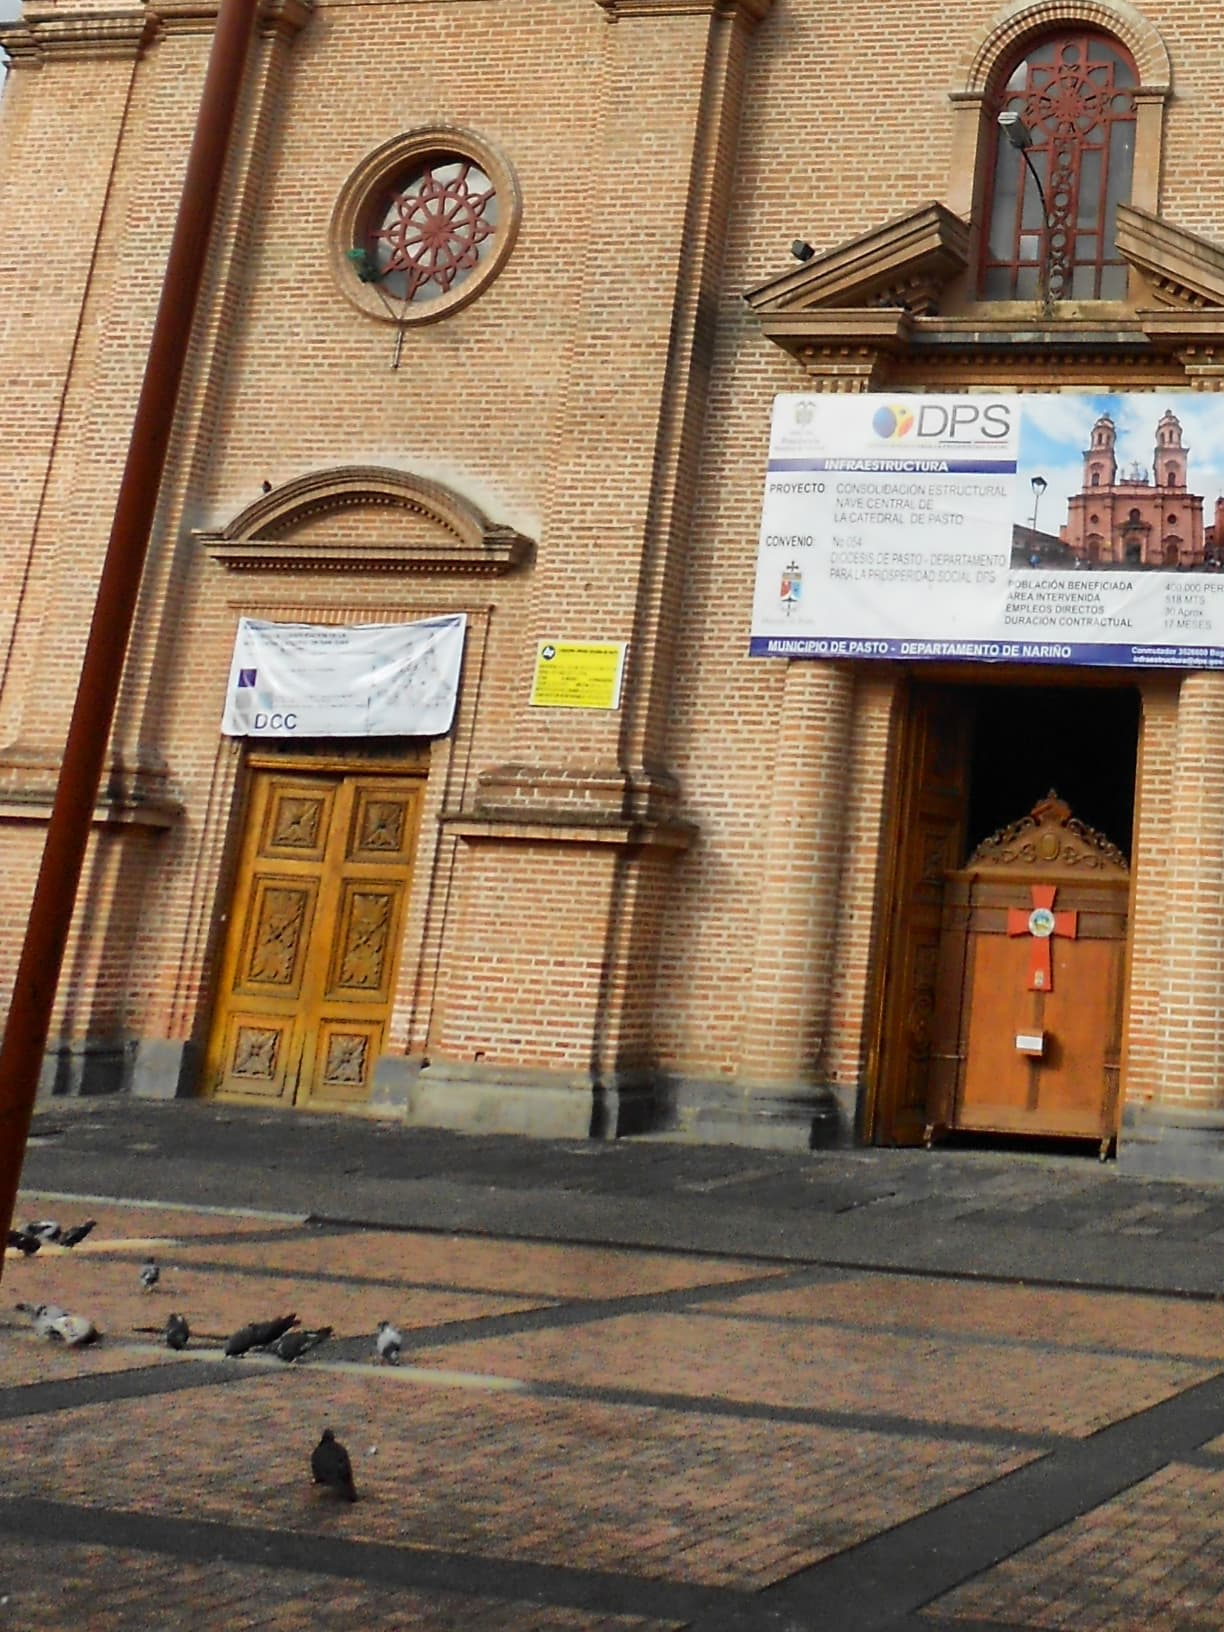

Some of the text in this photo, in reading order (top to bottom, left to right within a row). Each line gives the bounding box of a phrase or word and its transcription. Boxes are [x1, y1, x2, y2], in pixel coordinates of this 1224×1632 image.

[917, 403, 1011, 438] DPS
[824, 459, 949, 472] INFRAESTRUCTURA
[769, 482, 826, 494] PROYECTO
[928, 484, 1007, 497] ESTRUCTURAL
[836, 497, 934, 510] NAVE CENTRAL DE
[834, 512, 965, 525] LA CATEDRAL DE PASTO
[876, 552, 889, 565] DE
[892, 552, 921, 566] PASTO
[930, 553, 1006, 567] DEPARTAMENTO
[830, 567, 853, 580] PARA
[855, 568, 865, 580] LA
[869, 568, 935, 582] PROSPERIDAD
[938, 569, 971, 583] SOCIAL
[1008, 579, 1065, 590] POBLACIÓN
[1068, 580, 1133, 591] BENEFICIADA
[1036, 592, 1101, 603] INTERVENIDA
[1185, 595, 1205, 606] MTS
[1005, 603, 1052, 614] EMPLEOS
[1055, 604, 1104, 615] DIRECTOS
[1059, 616, 1133, 628] CONTRACTUAL
[1177, 619, 1212, 631] MESES
[768, 639, 827, 652] MUNICIPIO
[831, 640, 847, 653] DE
[849, 640, 889, 654] PASTO
[901, 642, 1000, 656] DEPARTAMENTO
[1002, 643, 1019, 656] DE
[1022, 643, 1072, 657] NARIÑO
[254, 713, 298, 730] DCC
